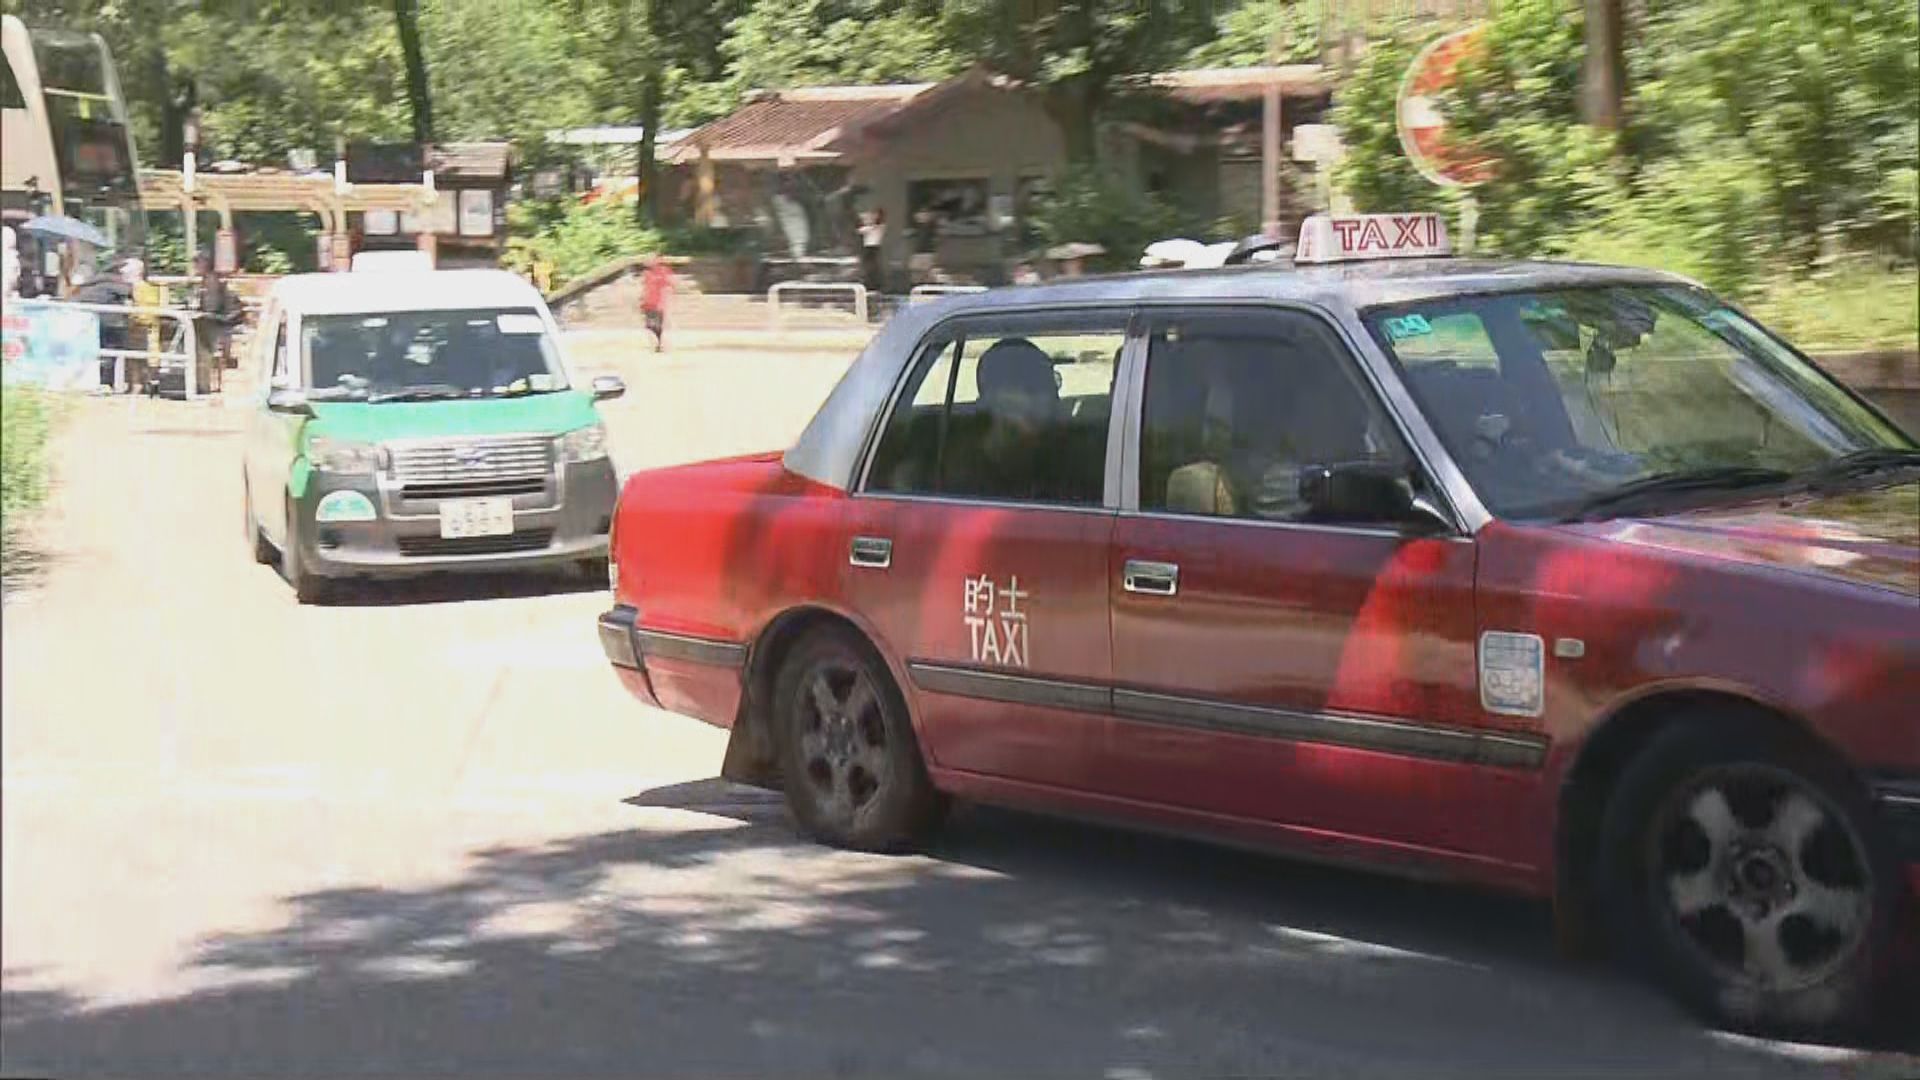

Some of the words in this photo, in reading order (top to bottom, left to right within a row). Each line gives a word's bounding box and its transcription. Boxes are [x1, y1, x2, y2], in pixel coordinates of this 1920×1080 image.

[1333, 216, 1438, 251] TAXI
[964, 573, 1028, 620] 的士
[963, 616, 1029, 668] TAXI
